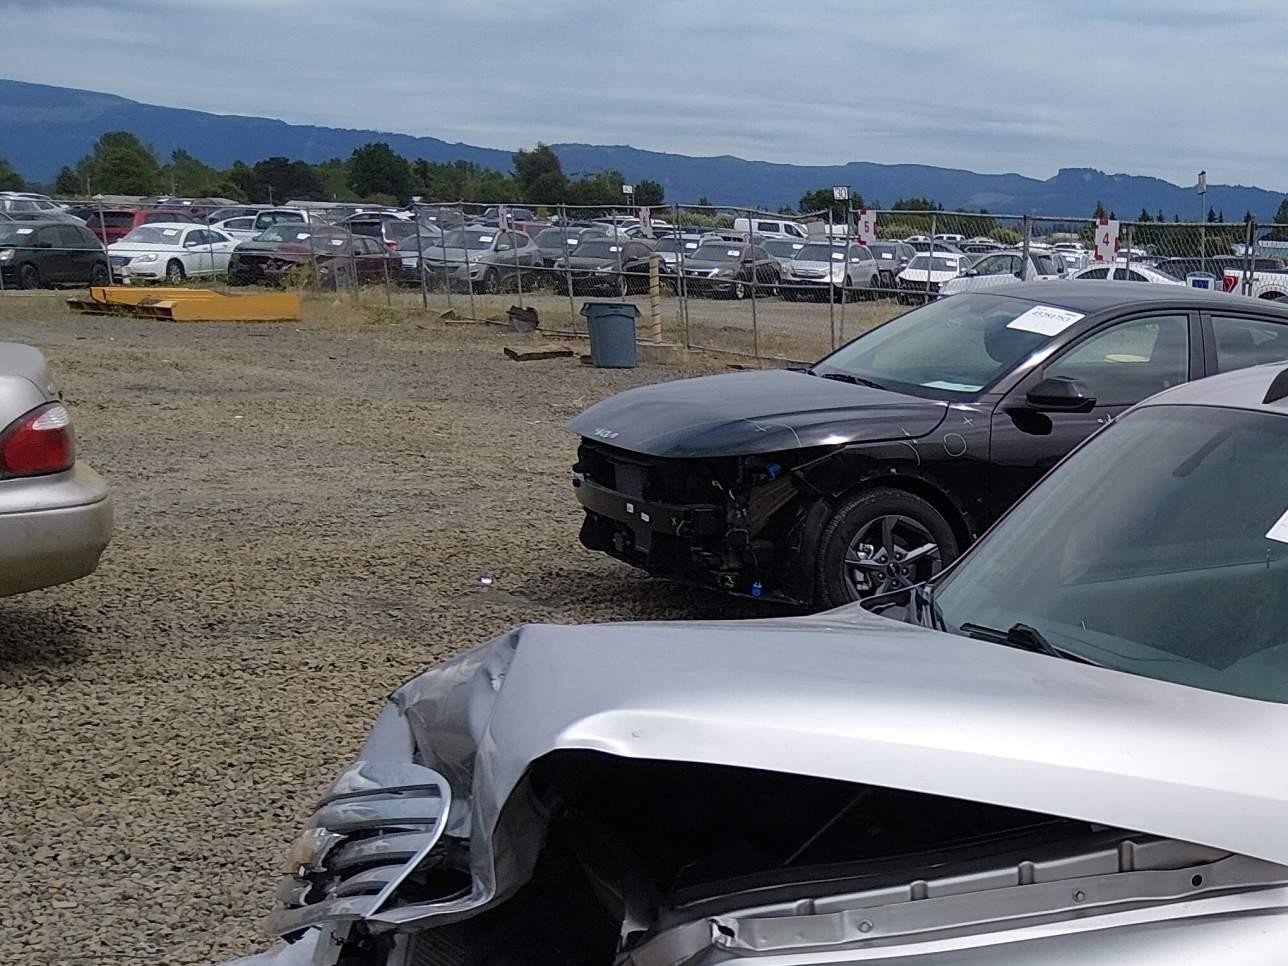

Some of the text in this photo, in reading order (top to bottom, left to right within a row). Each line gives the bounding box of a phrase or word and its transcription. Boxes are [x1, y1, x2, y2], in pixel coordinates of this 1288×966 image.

[835, 187, 847, 199] 30
[864, 221, 870, 233] 5
[1103, 232, 1109, 246] 4
